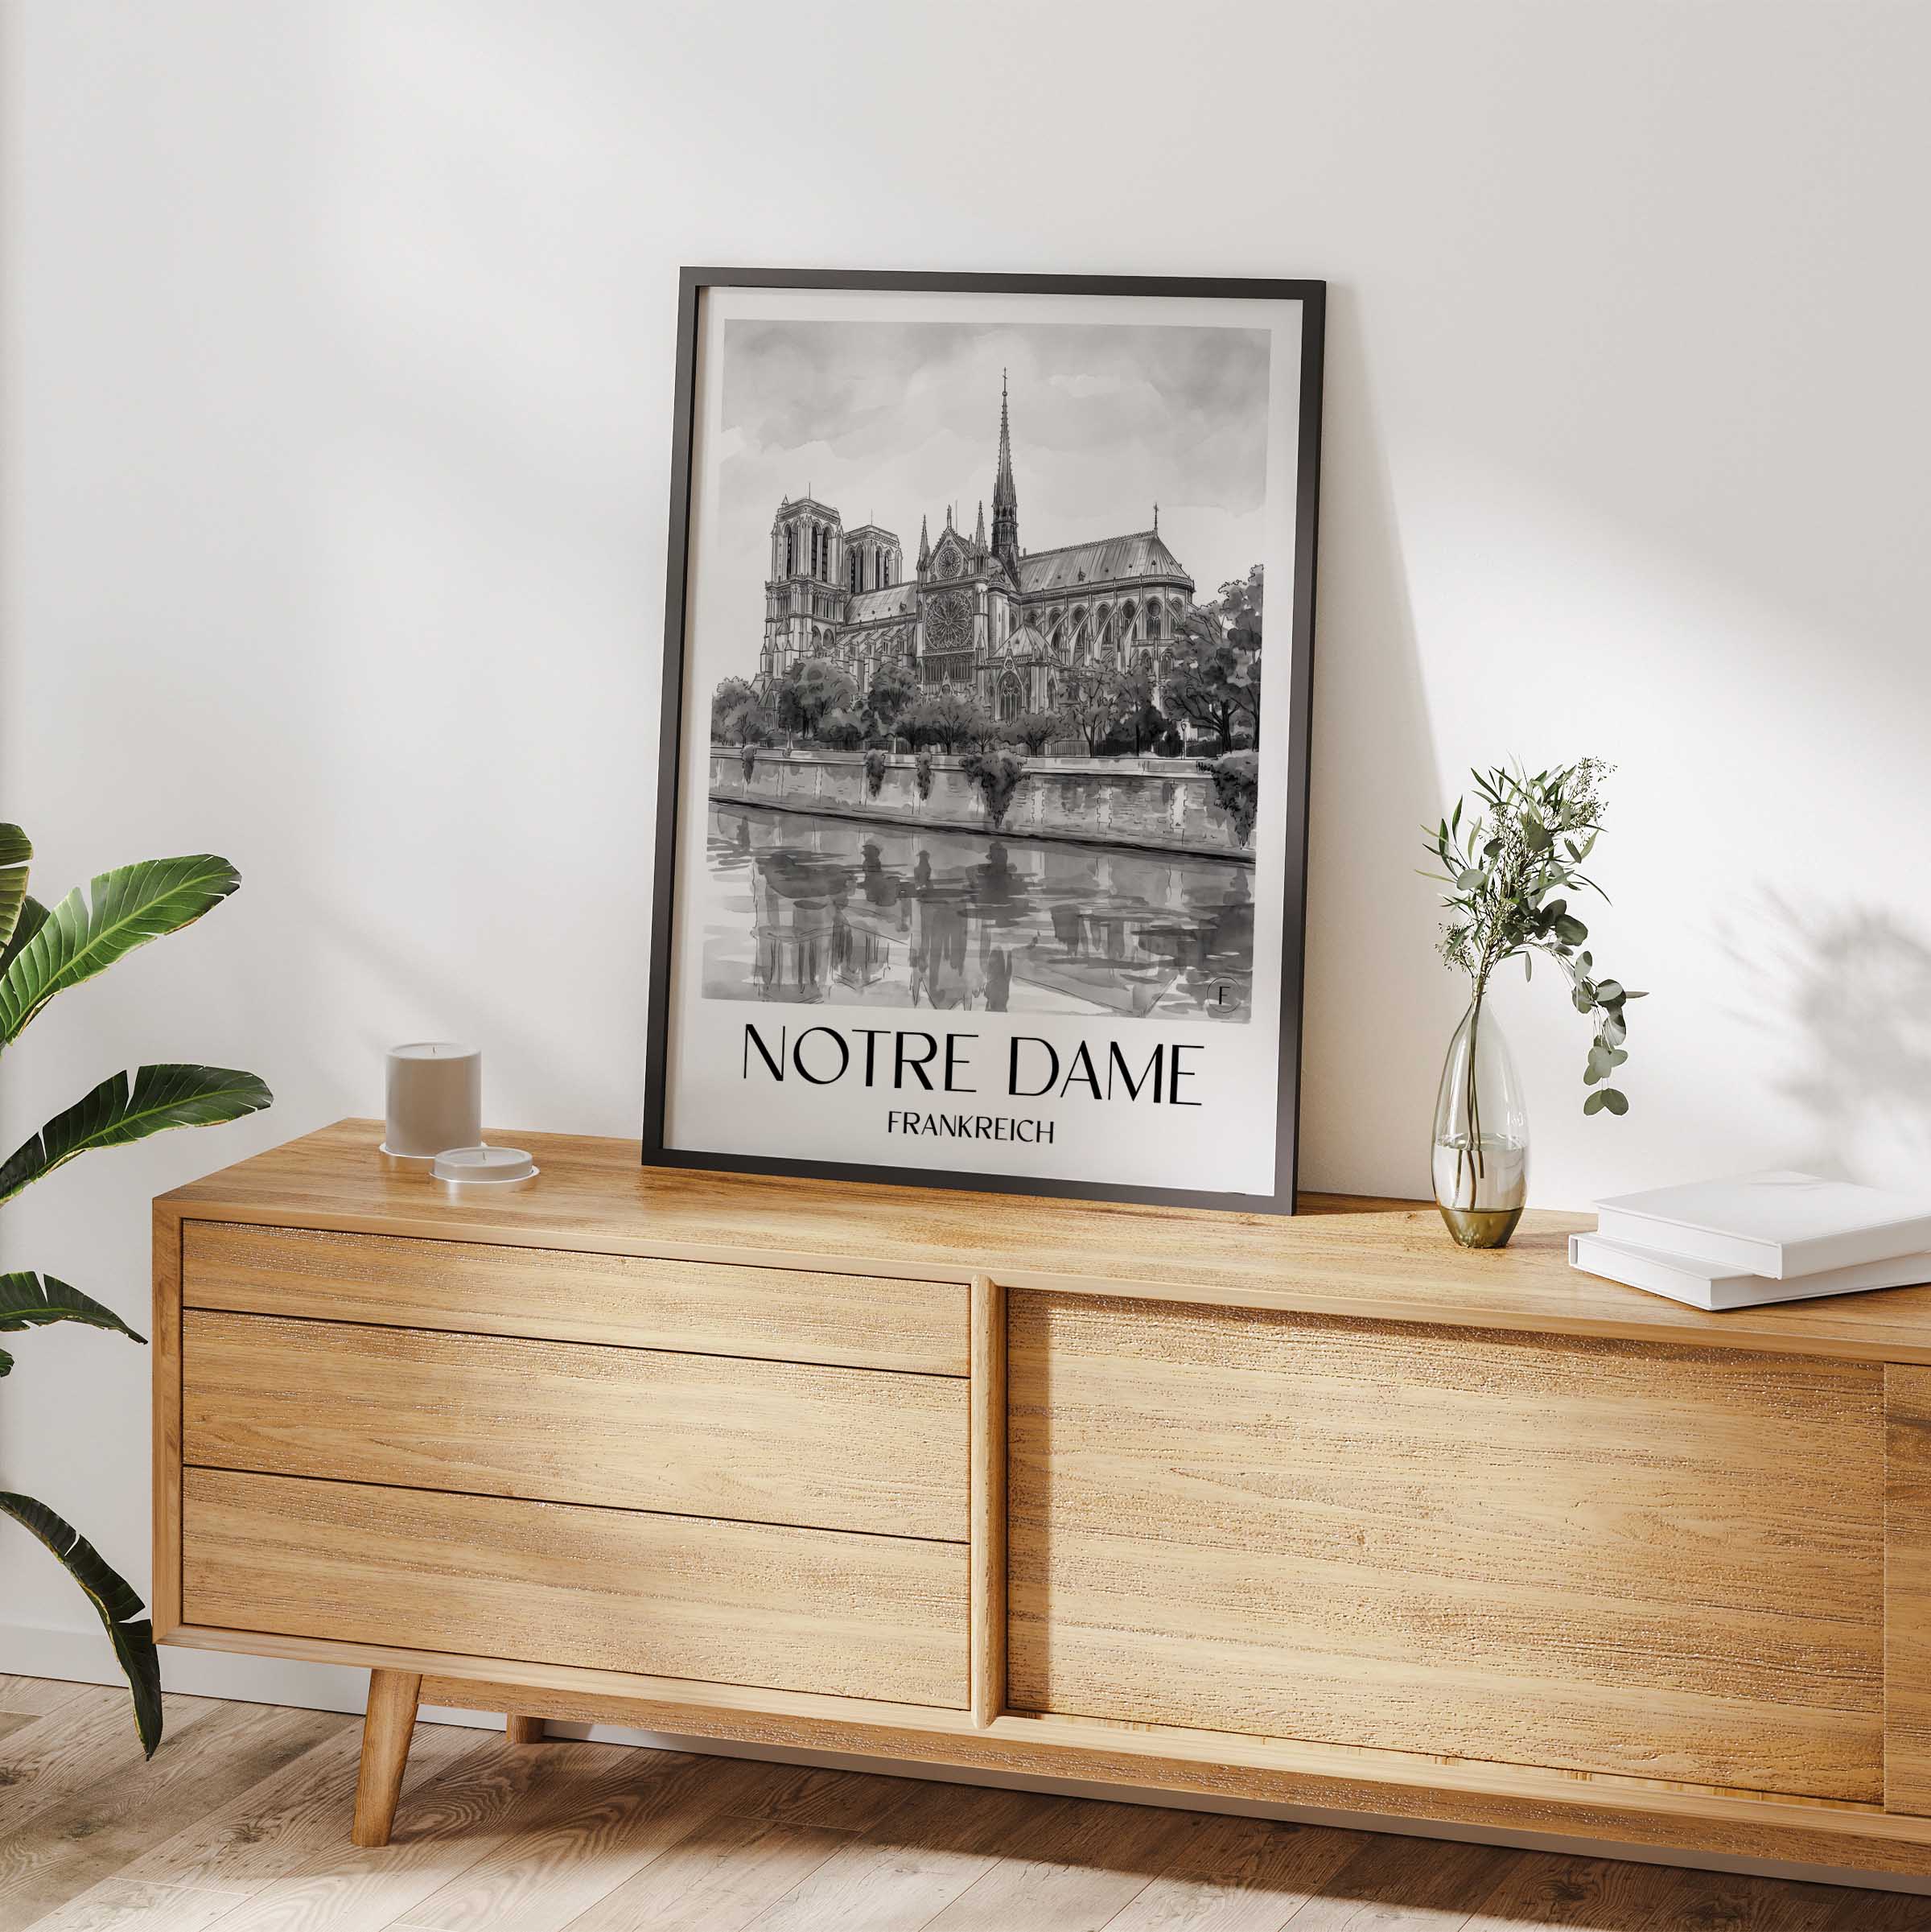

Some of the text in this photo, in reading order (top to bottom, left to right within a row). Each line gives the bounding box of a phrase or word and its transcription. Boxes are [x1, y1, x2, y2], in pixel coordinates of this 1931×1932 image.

[1218, 986, 1231, 1005] F
[743, 1023, 1205, 1106] NOTRE DAME
[887, 1110, 1056, 1144] FRANKREICH
